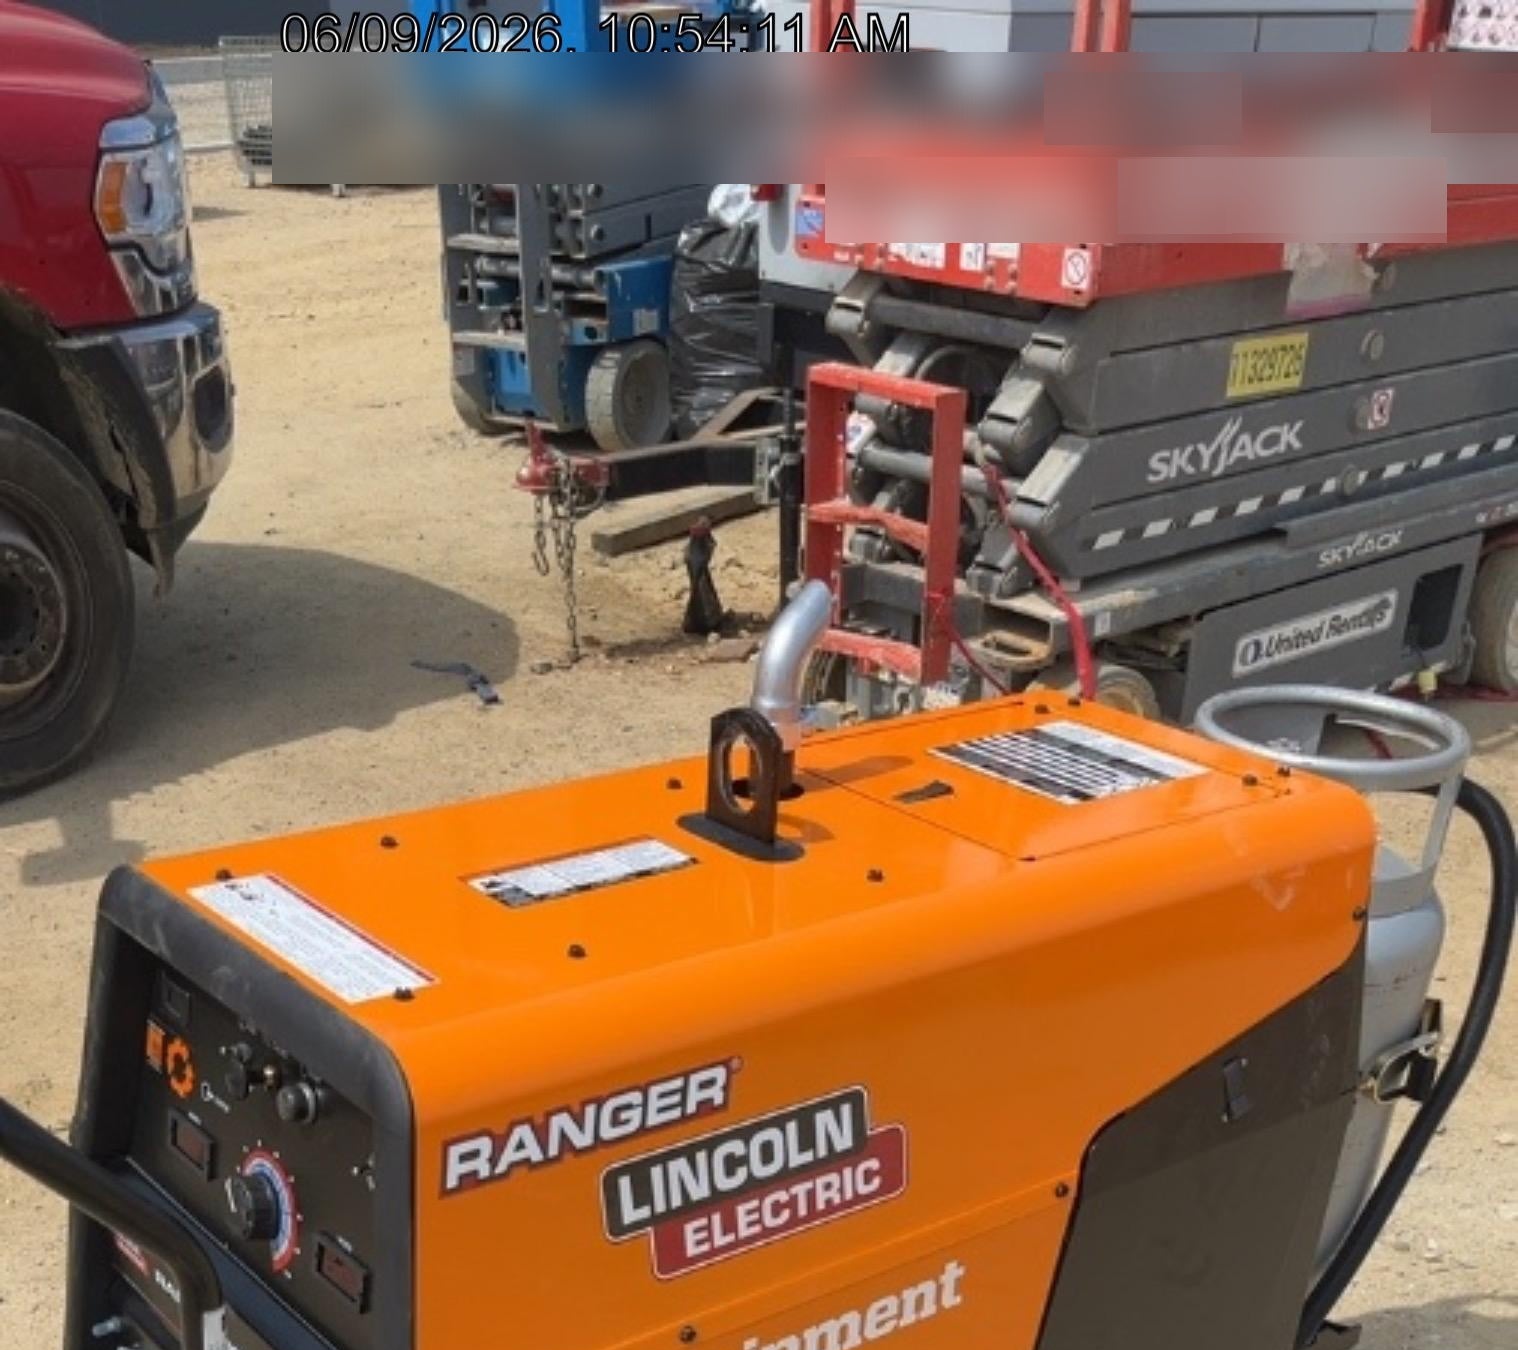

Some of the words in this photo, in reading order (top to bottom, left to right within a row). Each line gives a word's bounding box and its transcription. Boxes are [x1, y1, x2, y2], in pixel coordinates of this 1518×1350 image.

[1146, 415, 1304, 482] SKYJACK
[1265, 620, 1325, 658] United
[616, 1102, 854, 1226] LINCOLN
[682, 1157, 882, 1259] ELECTRIC
